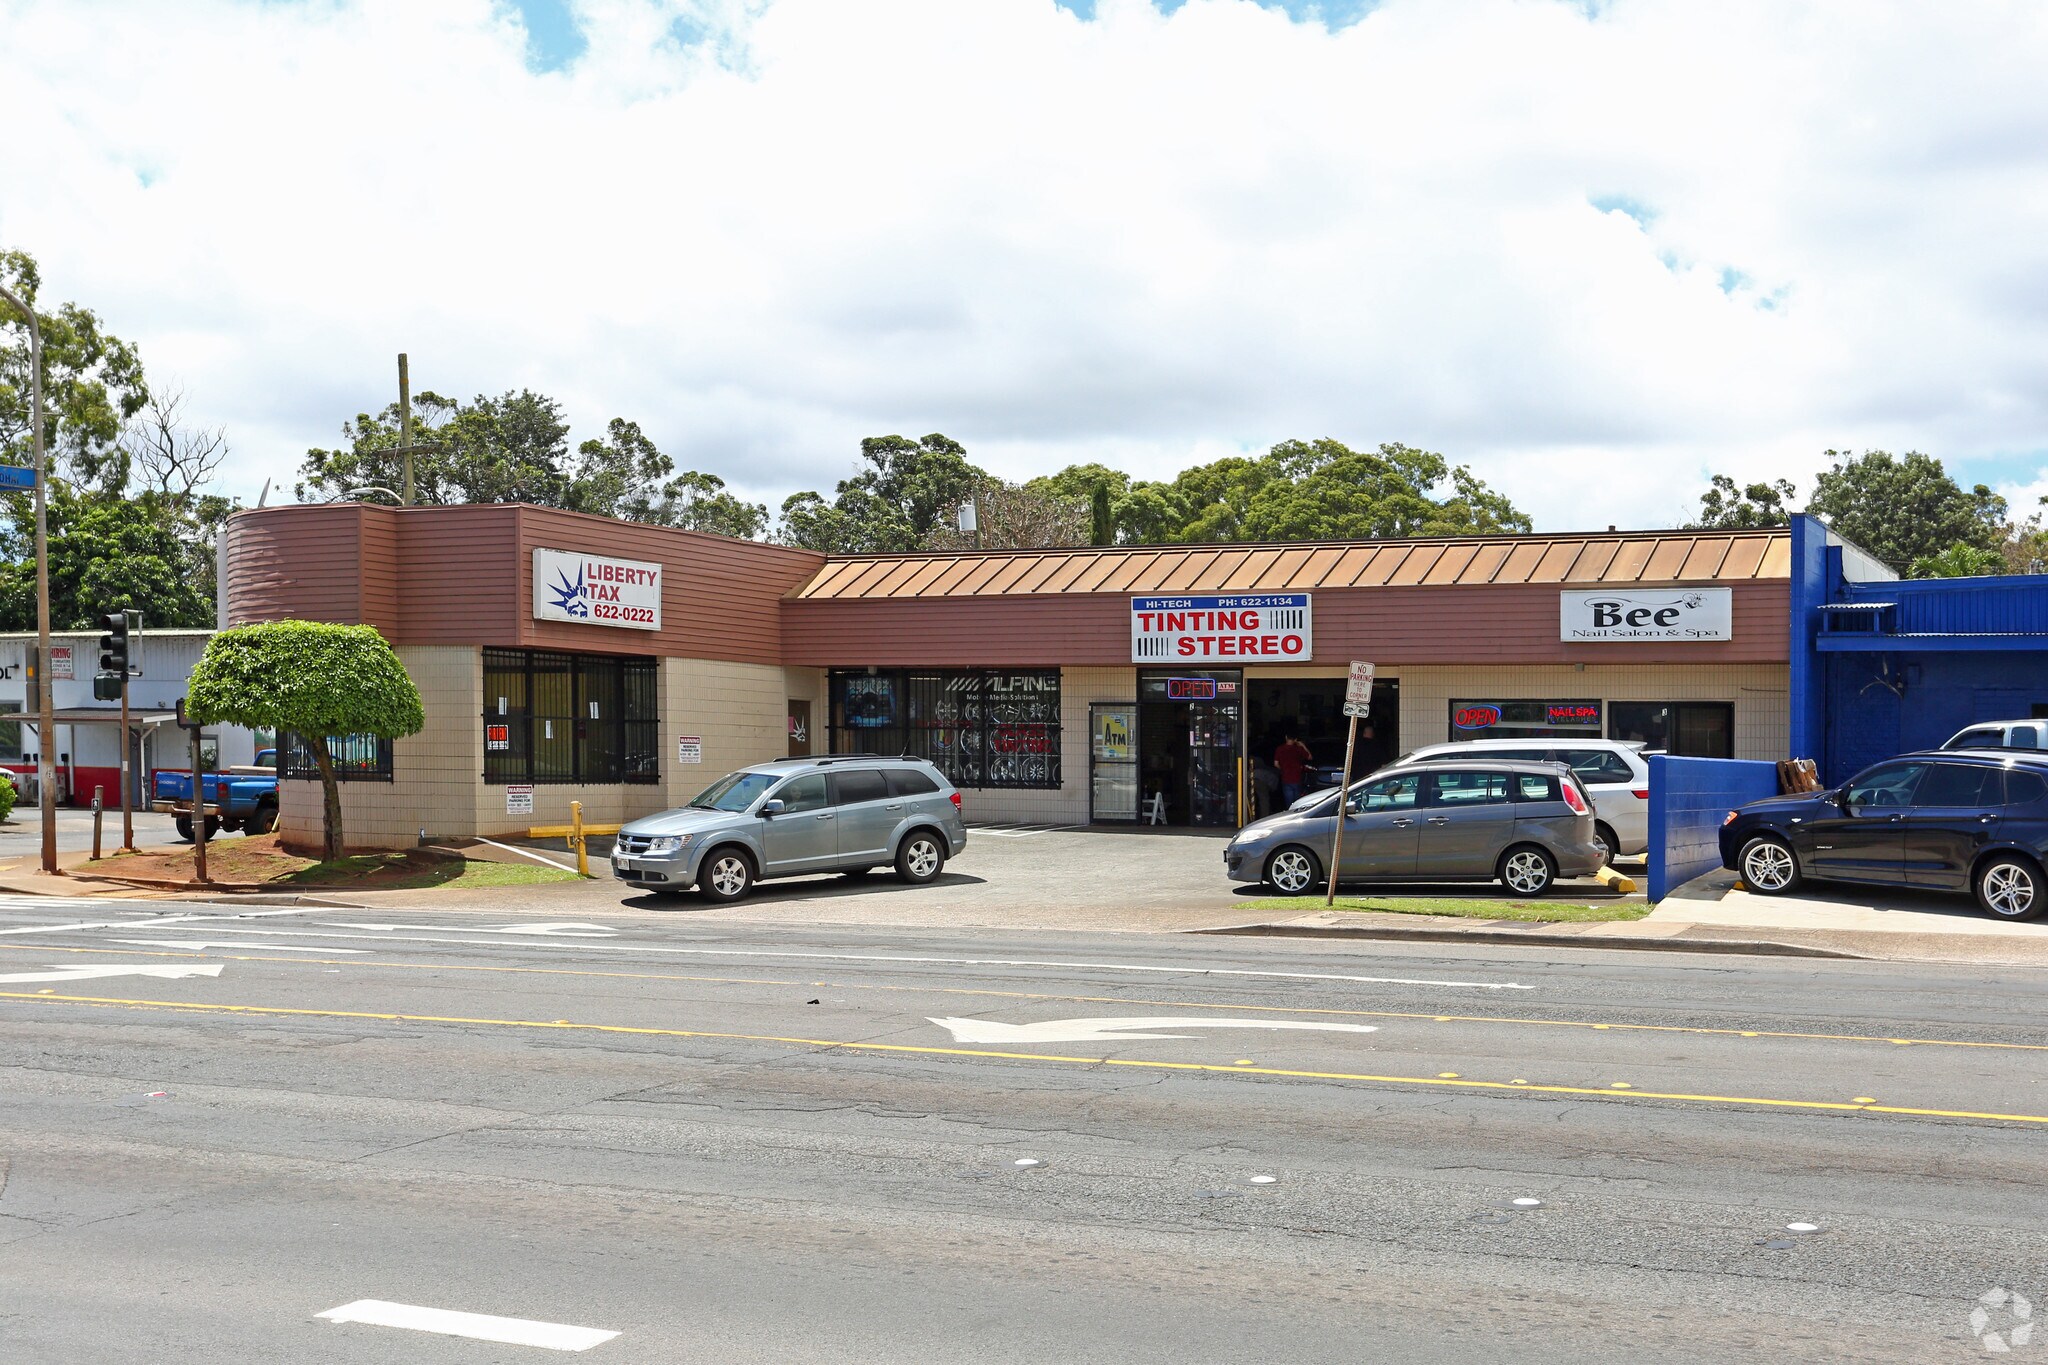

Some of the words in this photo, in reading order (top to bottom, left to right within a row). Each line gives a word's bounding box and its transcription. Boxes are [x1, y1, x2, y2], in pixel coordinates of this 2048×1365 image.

[587, 563, 657, 587] LIBERTY
[588, 583, 620, 602] TAX
[1146, 600, 1192, 609] HI-TECH
[1218, 599, 1238, 607] PH:
[1241, 597, 1293, 606] 622-1134
[594, 604, 654, 623] 622-0222
[1137, 610, 1260, 632] TINTING
[1592, 602, 1680, 628] Bee
[1572, 629, 1607, 637] Nail
[1611, 629, 1661, 637] Salon
[1665, 629, 1681, 637] &
[1685, 629, 1719, 638] Spa
[1177, 635, 1304, 656] STEREO
[1350, 672, 1373, 682] PARKING
[1357, 665, 1367, 674] NO
[985, 676, 1058, 692] ALPINE
[1170, 681, 1214, 697] OPEN
[1455, 709, 1497, 725] OPEN
[1549, 707, 1575, 717] NAIL
[1576, 707, 1597, 717] SPA
[1104, 723, 1127, 746] ATM
